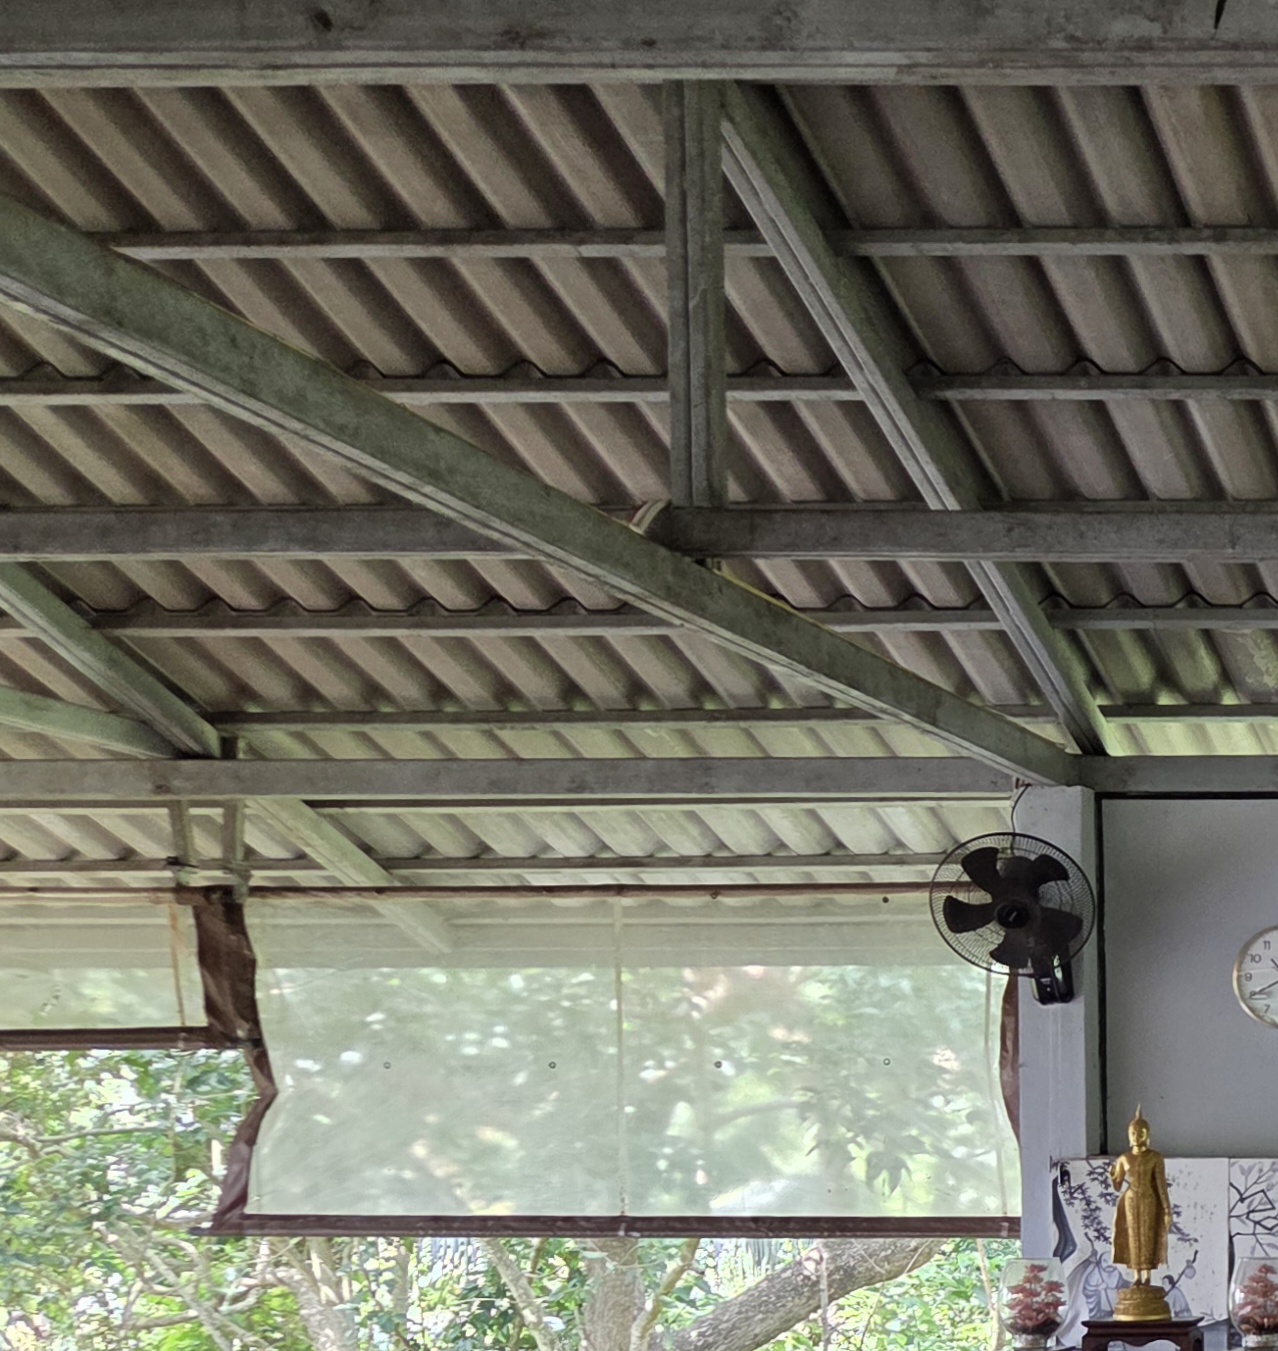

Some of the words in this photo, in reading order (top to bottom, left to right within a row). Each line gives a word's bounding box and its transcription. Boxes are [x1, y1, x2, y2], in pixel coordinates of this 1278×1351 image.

[1263, 940, 1271, 951] 11
[1250, 954, 1262, 963] 10
[1244, 972, 1253, 982] 9
[1263, 1004, 1271, 1014] 7
